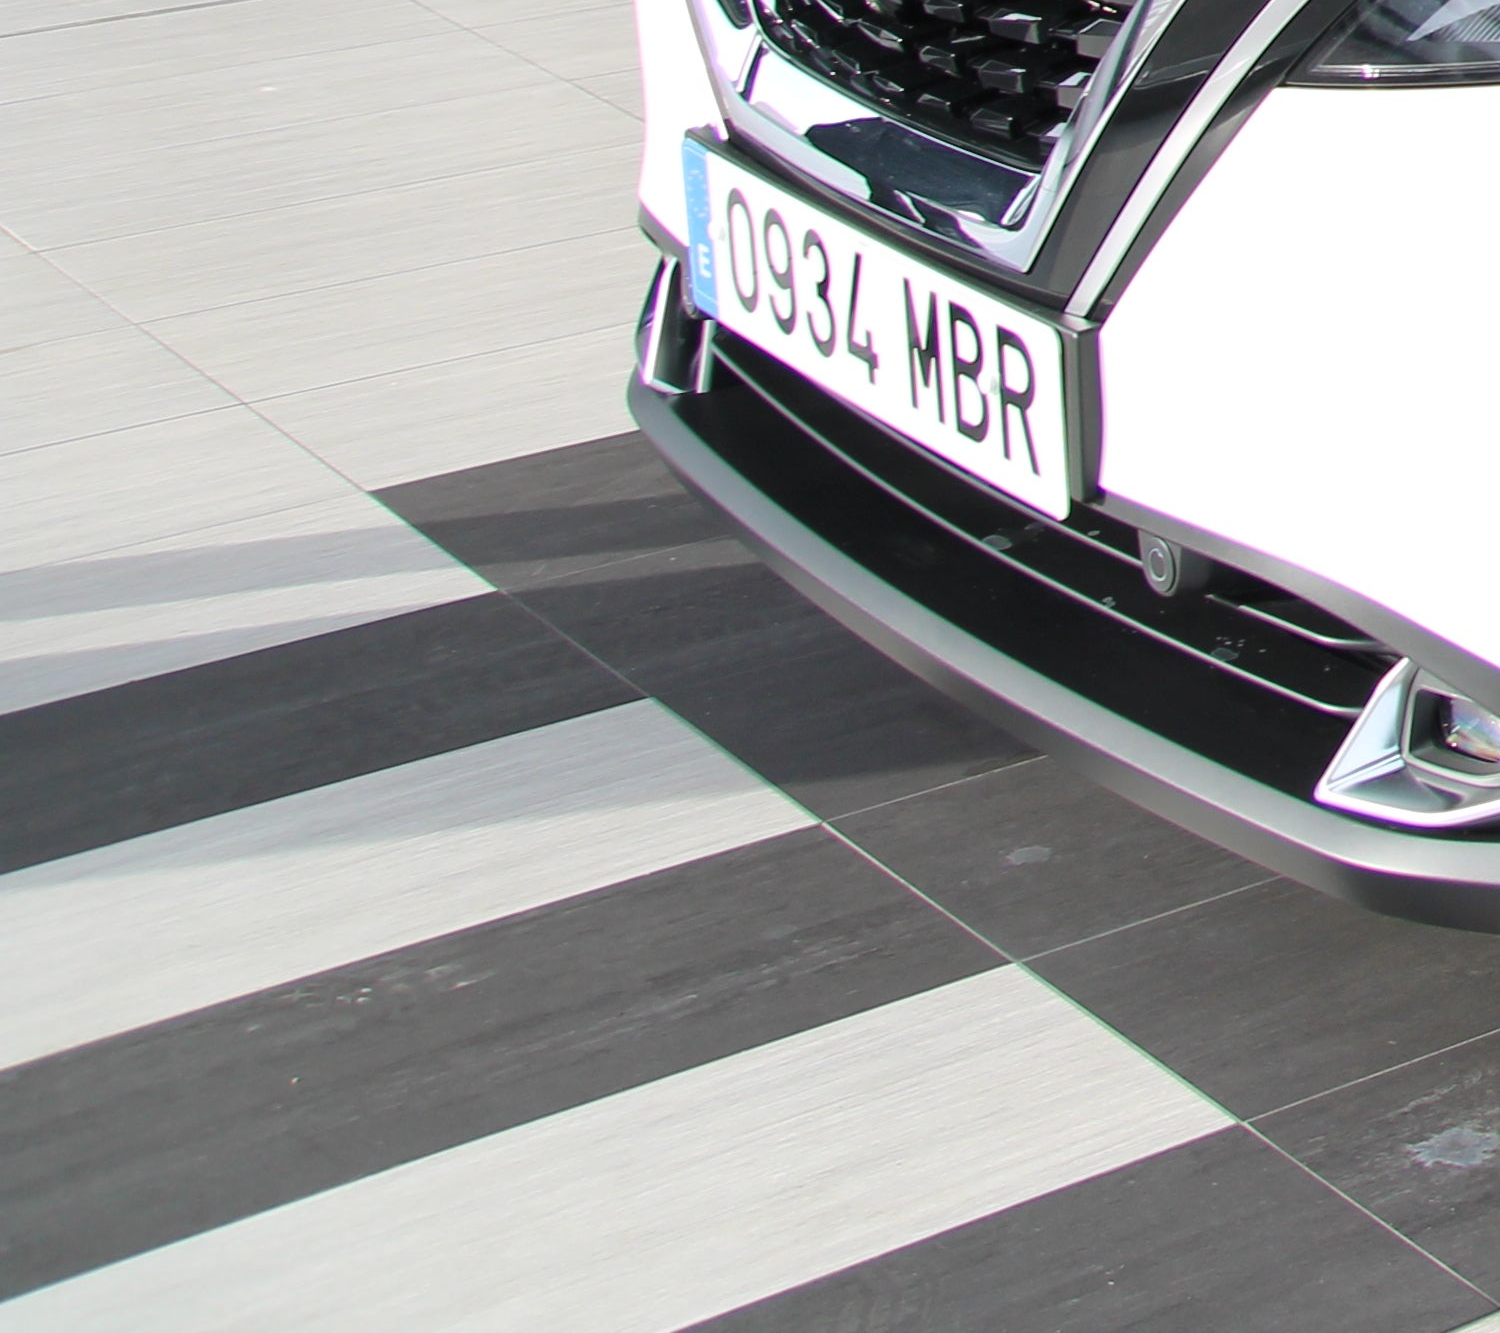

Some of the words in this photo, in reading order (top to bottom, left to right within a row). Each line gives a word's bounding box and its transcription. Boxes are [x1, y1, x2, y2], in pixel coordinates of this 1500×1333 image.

[696, 242, 712, 279] E
[726, 187, 880, 383] 0934
[902, 275, 1042, 479] MBR
